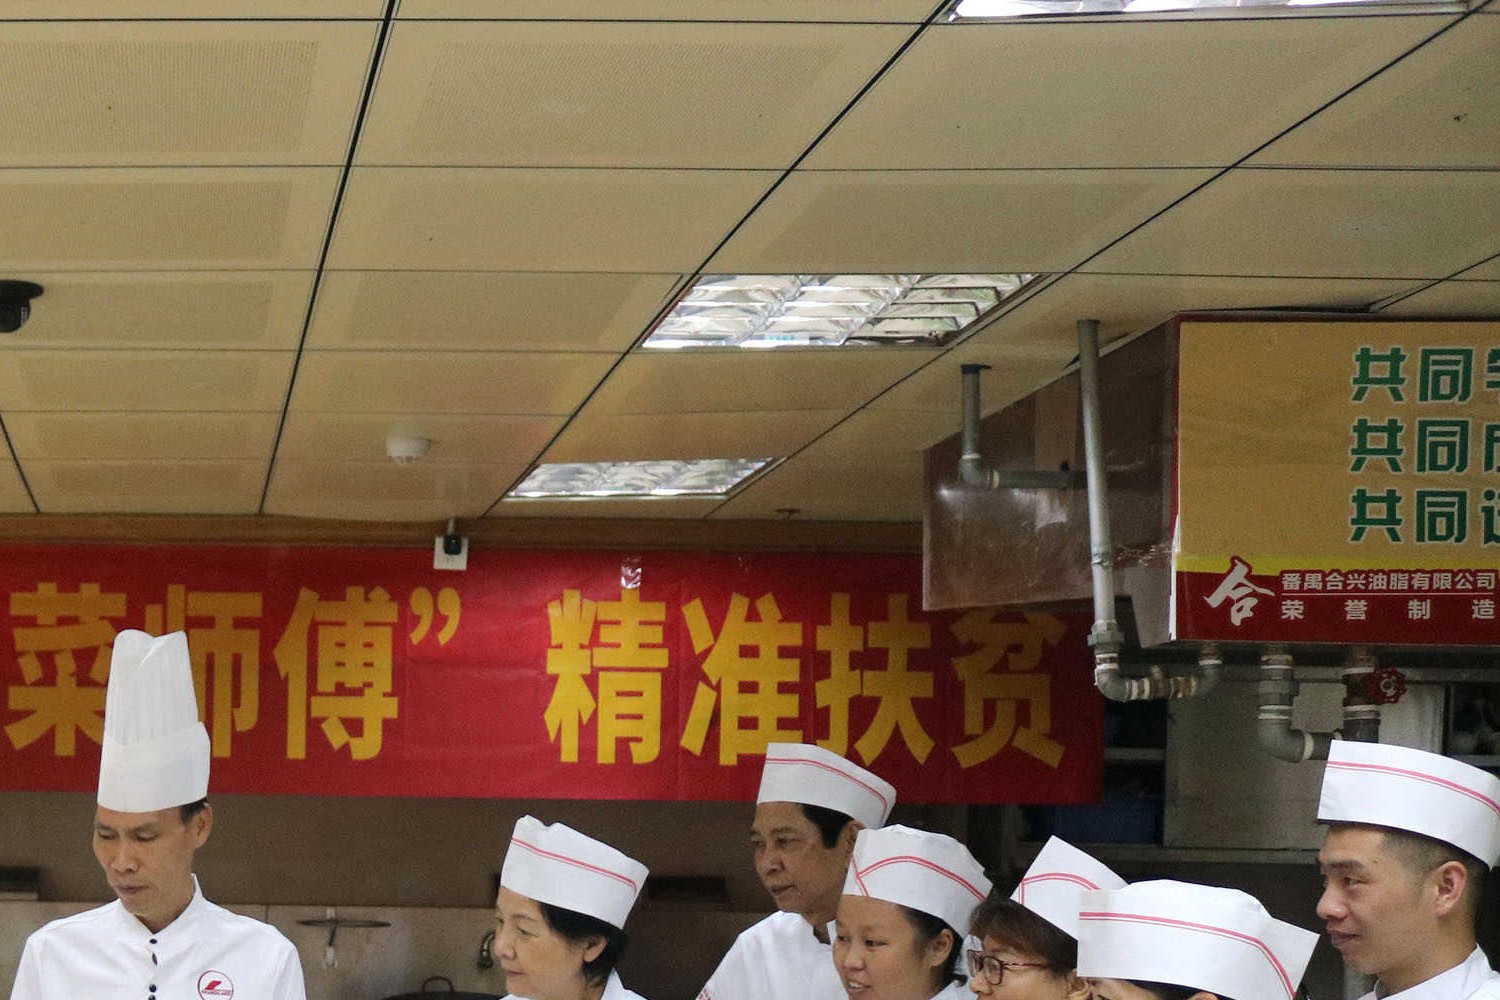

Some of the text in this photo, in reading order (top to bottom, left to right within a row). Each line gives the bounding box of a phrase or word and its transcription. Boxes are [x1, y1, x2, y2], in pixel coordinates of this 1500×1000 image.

[1350, 347, 1500, 402] 共同
[1349, 418, 1500, 472] 共同
[1349, 489, 1500, 544] 共同
[1282, 573, 1496, 590] 番禺合兴油脂有限公司
[1281, 599, 1496, 621] 荣誉制造
